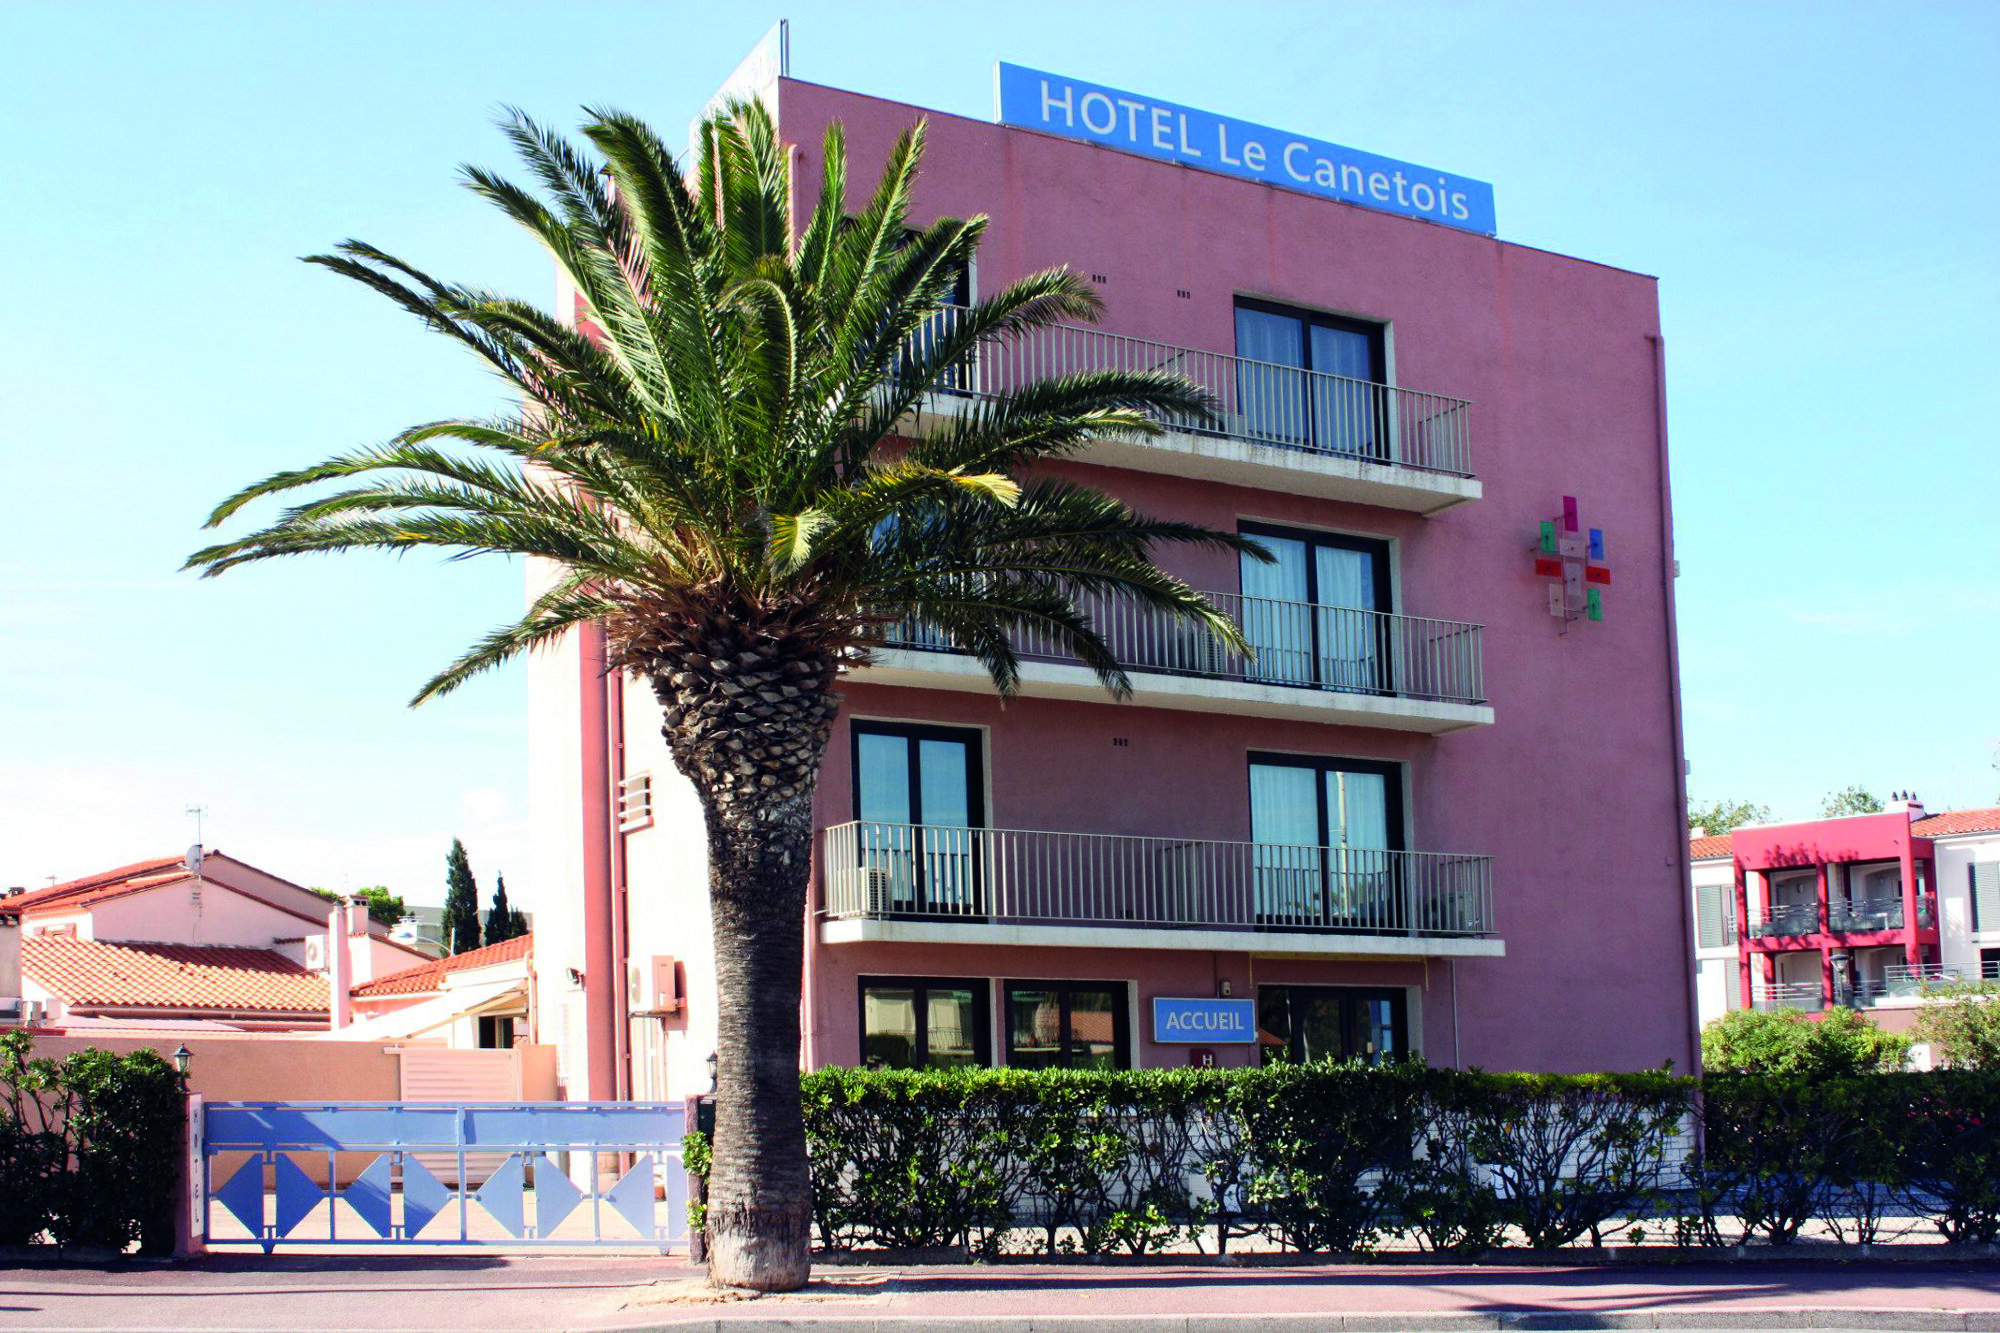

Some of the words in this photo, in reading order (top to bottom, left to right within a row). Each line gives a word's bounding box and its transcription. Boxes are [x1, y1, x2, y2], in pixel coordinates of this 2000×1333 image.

[1040, 79, 1202, 157] HOTEL
[1218, 123, 1267, 171] Le
[1283, 141, 1470, 220] Canetois
[1165, 1010, 1245, 1030] ACCUEIL
[1202, 1054, 1213, 1066] H
